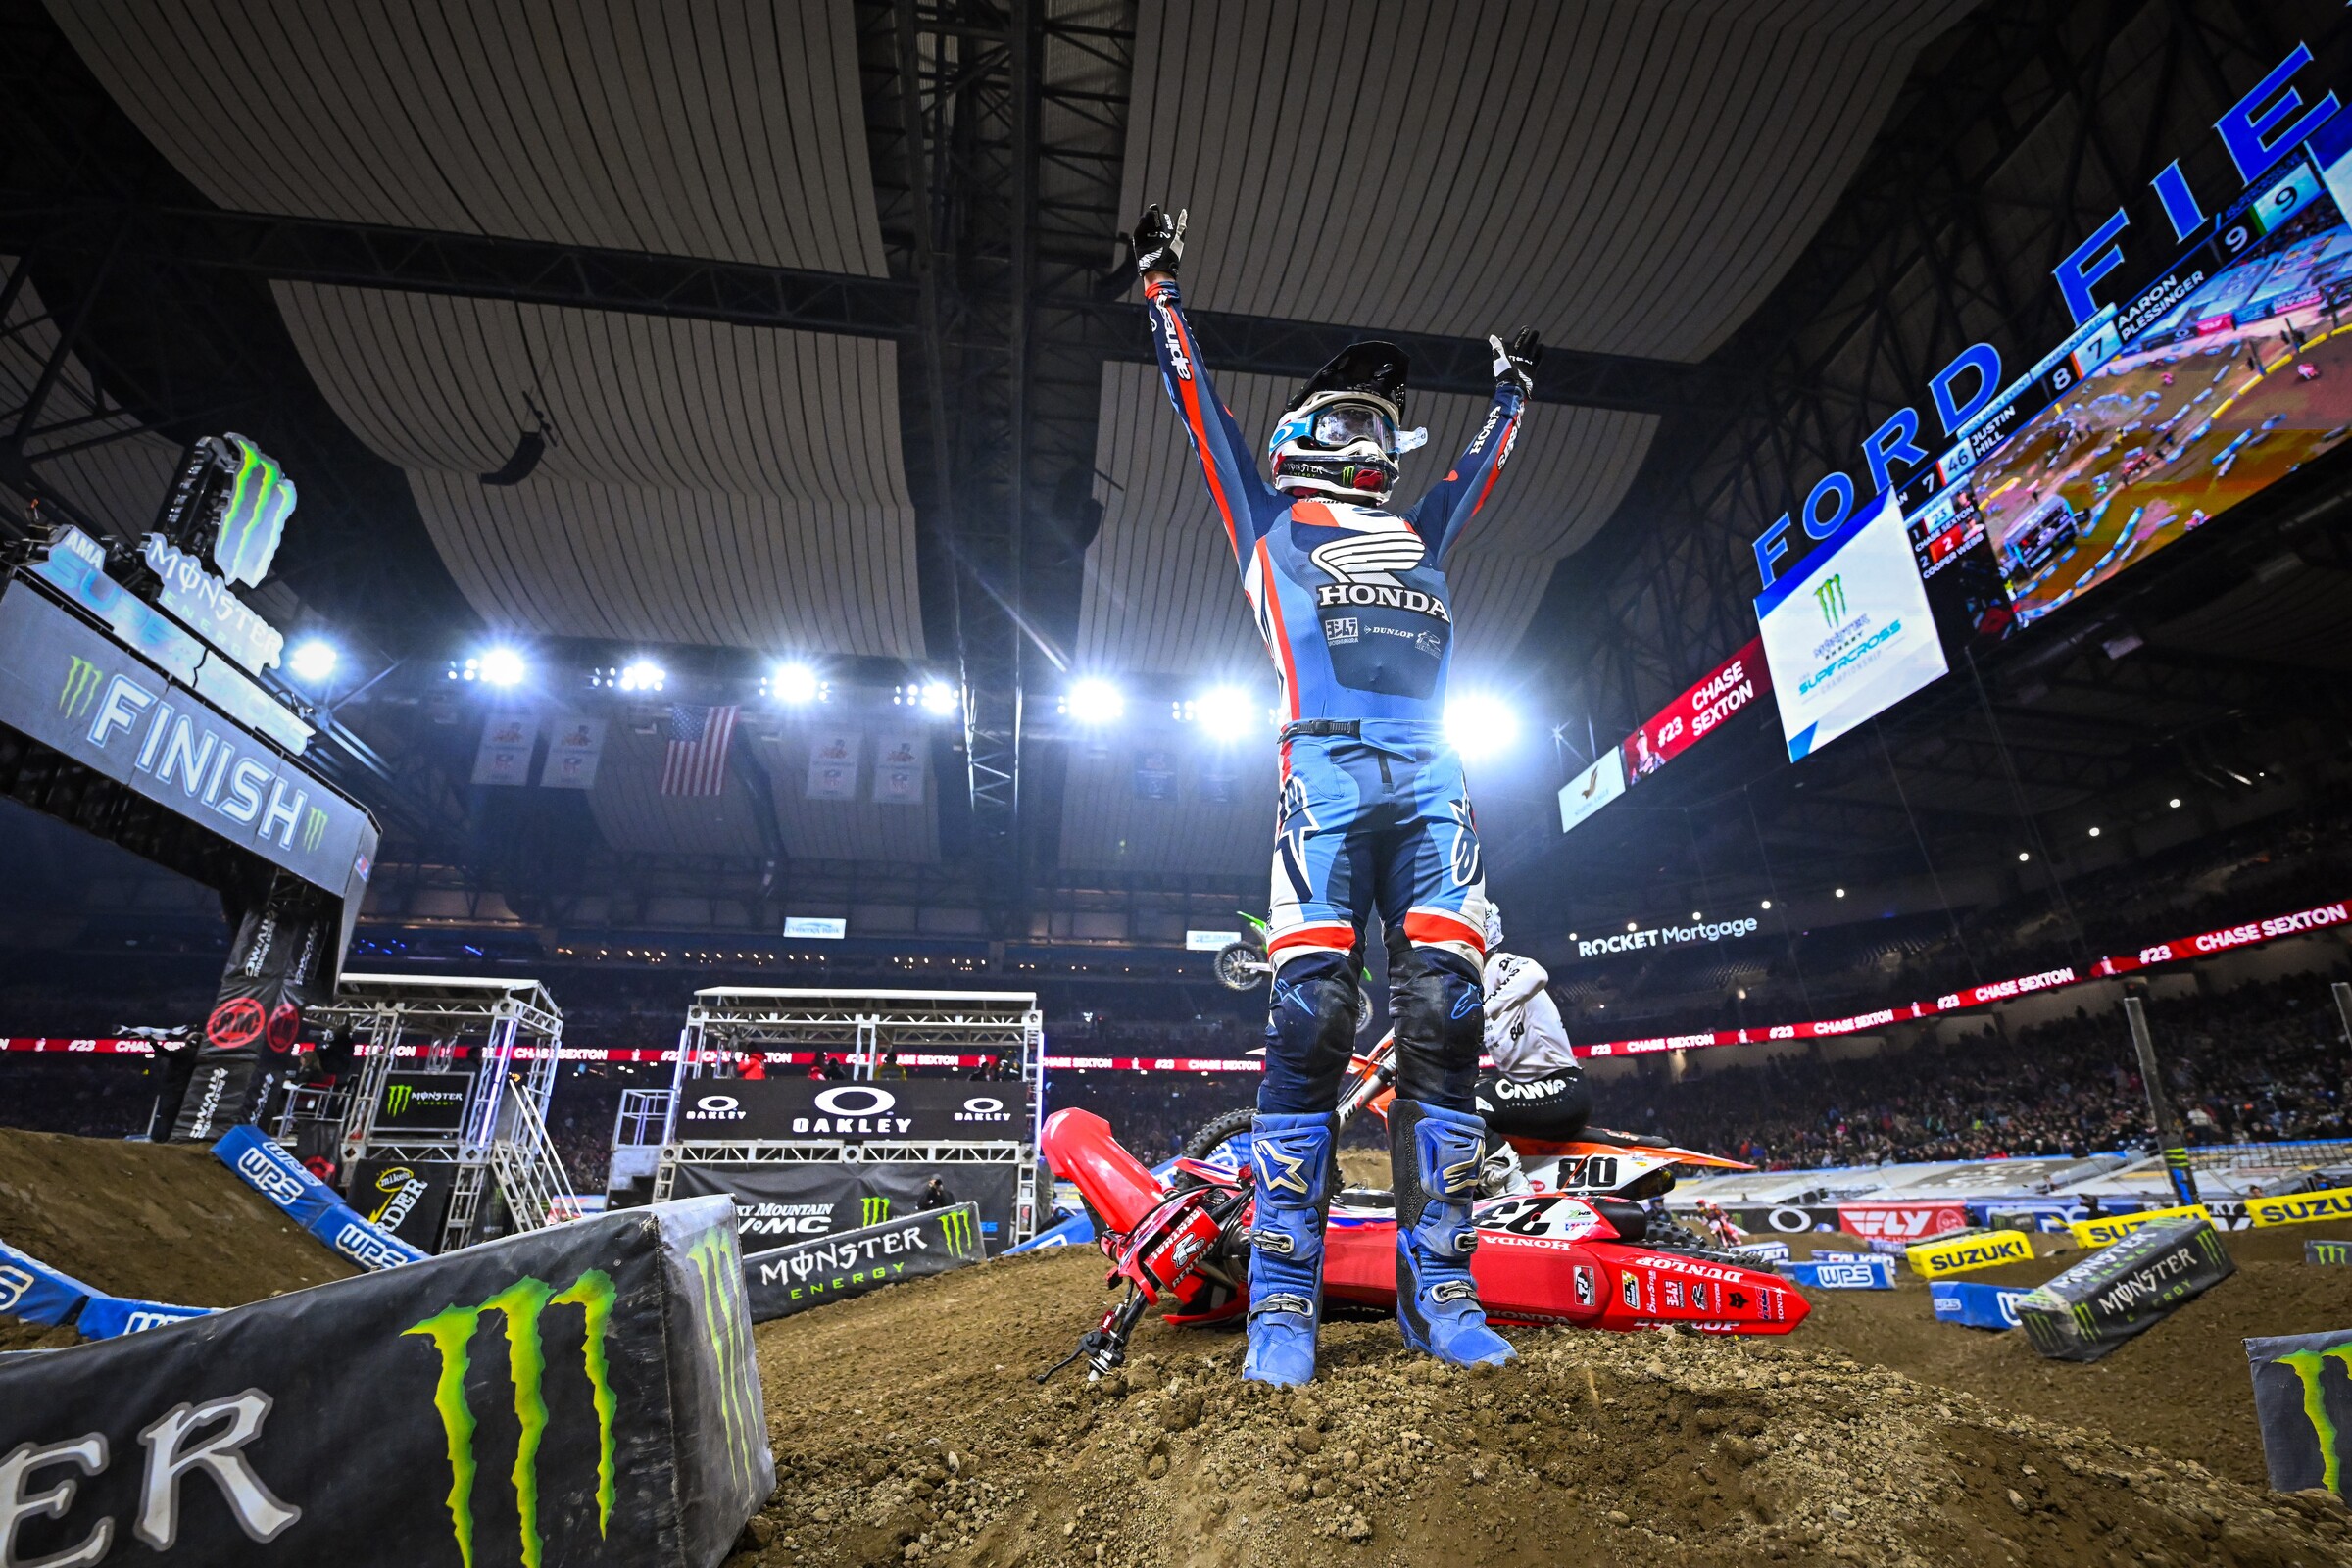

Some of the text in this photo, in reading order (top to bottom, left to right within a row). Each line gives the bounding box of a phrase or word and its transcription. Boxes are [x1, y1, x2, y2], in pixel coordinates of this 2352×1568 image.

[2275, 186, 2298, 214] 9
[2224, 225, 2248, 253] 9
[2117, 273, 2178, 329] AARON
[2121, 270, 2205, 341] PLESSINGER
[2087, 337, 2103, 360] 7
[2052, 368, 2072, 391] 8
[1469, 406, 1501, 455] HONA
[1970, 405, 2016, 446] JUSTIN
[1975, 432, 2005, 458] HILL
[1752, 342, 2002, 591] FORD
[1947, 448, 1970, 472] 46
[1922, 472, 1936, 494] 7
[1914, 504, 1975, 553] CHASE SEXTON
[1933, 507, 1948, 525] 23
[65, 531, 104, 571] AMA
[1942, 537, 1954, 551] 2
[1920, 556, 1930, 568] 2
[1923, 551, 1957, 579] COOPER
[150, 540, 281, 668] MONSTER
[1318, 584, 1451, 623] HONDA
[1373, 626, 1414, 639] DUNLOP
[1691, 660, 1745, 710] CHASE
[1691, 679, 1754, 737] SEXTON
[1657, 716, 1683, 748] #23
[86, 673, 308, 852] FINISH
[1578, 917, 1759, 956] ROCKET Mortgage
[2140, 904, 2347, 963] #23 CHASE SEXTON
[1937, 967, 2075, 1010] #23 CHASE SEXTON
[1770, 1009, 1893, 1039] #23 CHASE SEXTON
[68, 1040, 96, 1052] #23
[115, 1040, 155, 1053] CHAS
[559, 1048, 608, 1060] SEXTON
[1590, 1034, 1714, 1055] #23 CHASE SEXTON
[881, 1054, 915, 1065] CASE
[917, 1055, 959, 1066] SEXTON
[1072, 1057, 1113, 1069] SEXTON
[1154, 1058, 1261, 1071] #23 CHASE SEXTON
[686, 1110, 746, 1120] OAKLEY
[792, 1118, 912, 1133] OAKLEY
[954, 1112, 1011, 1121] OAKLEY
[237, 1147, 305, 1205] WPS
[1556, 1157, 1618, 1189] 80
[752, 1203, 834, 1217] MOUNTAIN
[1841, 1210, 1932, 1235] FLY
[760, 1226, 928, 1286] MONSTER
[1481, 1235, 1571, 1251] HONDA
[1930, 1241, 2024, 1271] SUZUKI
[1172, 1237, 1218, 1288] RENTHA
[1635, 1256, 1744, 1283] DUNLOP
[2052, 1232, 2158, 1289] MONSTER
[790, 1262, 906, 1299] ENERGY
[1816, 1264, 1874, 1288] WPS
[2098, 1248, 2198, 1316] MONSTER
[2126, 1278, 2193, 1323] ERGY
[1634, 1318, 1740, 1331] DULOP
